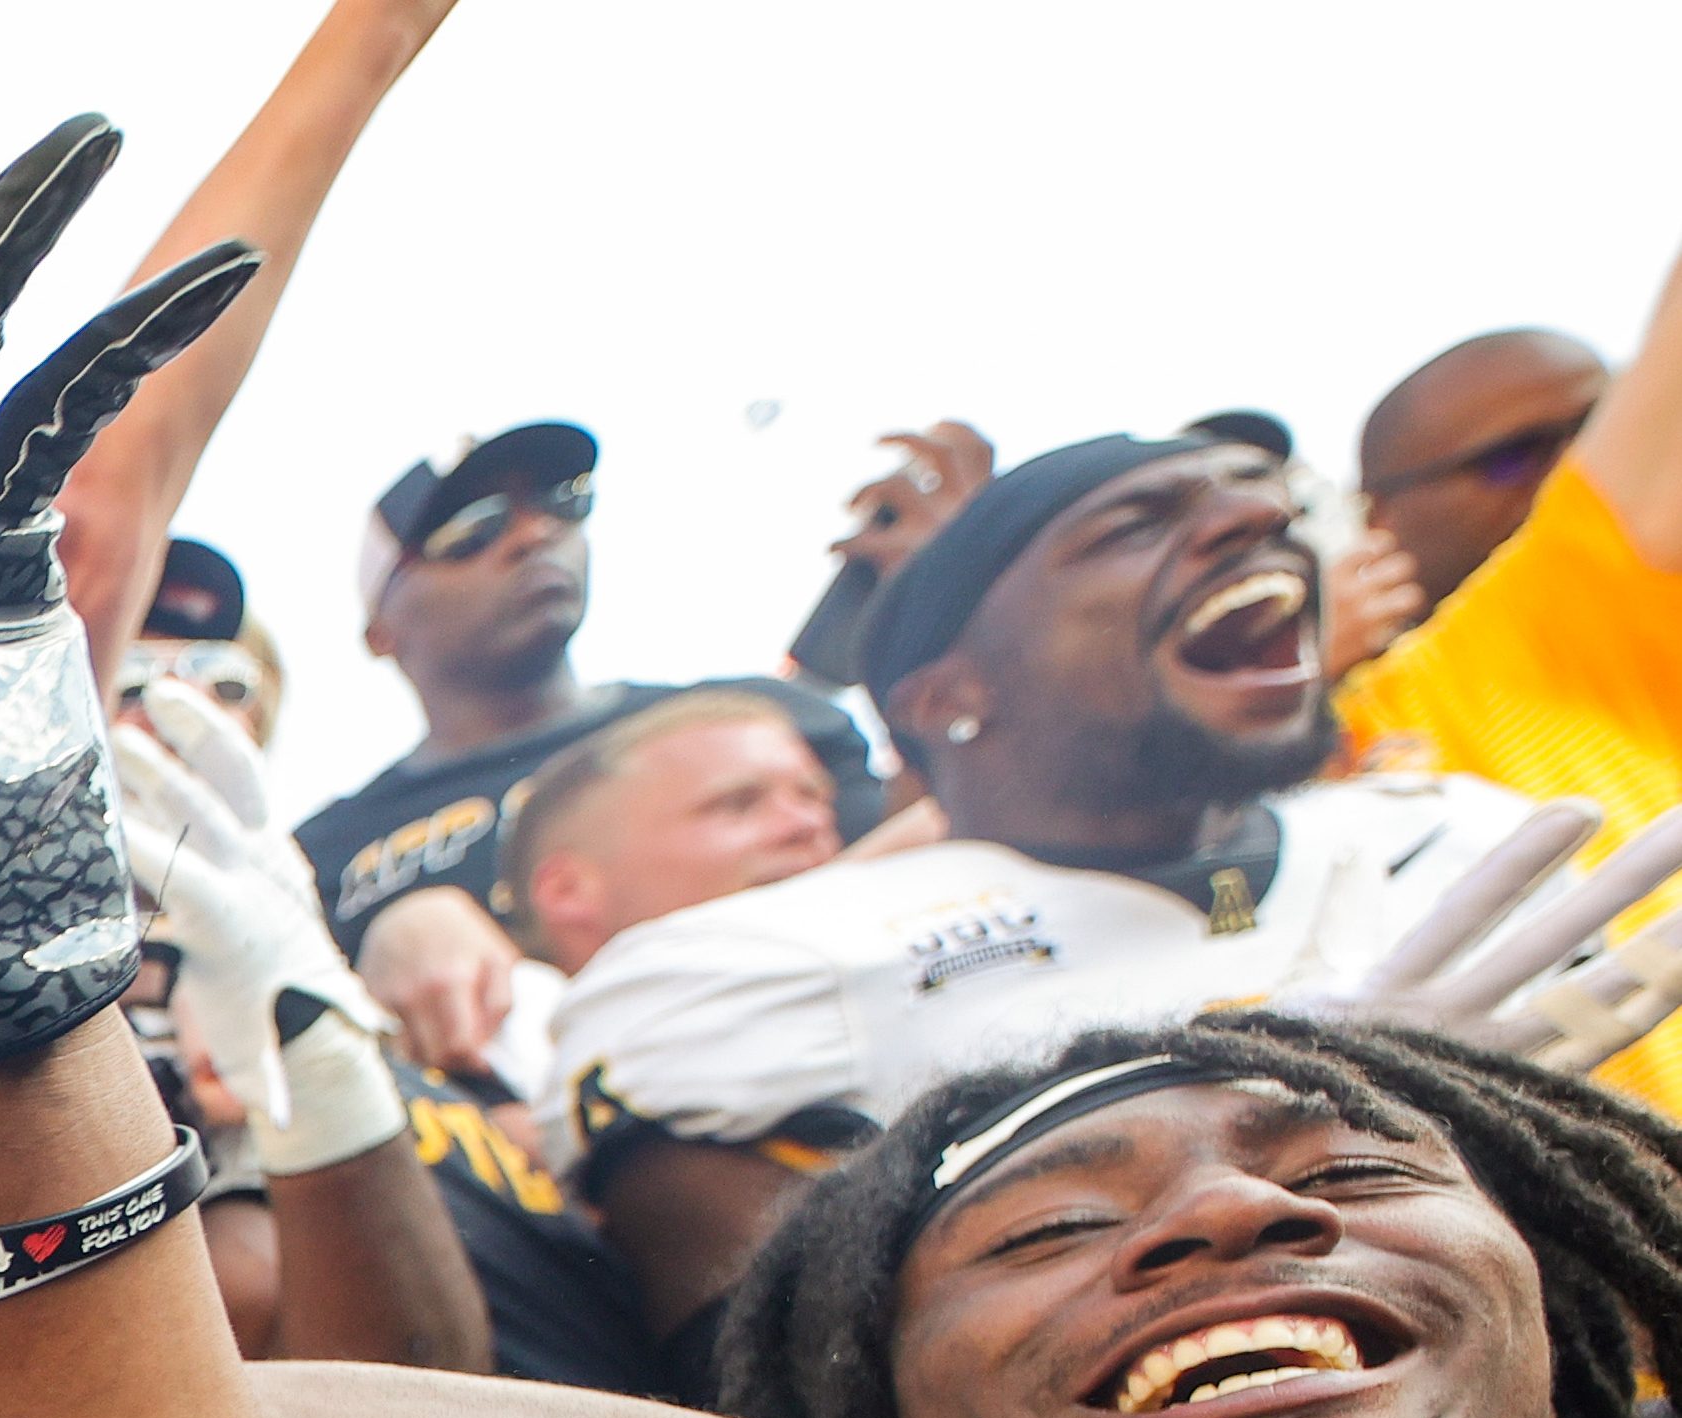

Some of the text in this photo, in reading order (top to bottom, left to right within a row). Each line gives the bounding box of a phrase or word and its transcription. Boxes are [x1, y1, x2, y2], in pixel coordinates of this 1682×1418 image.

[77, 1182, 165, 1233] THIS ONE
[81, 1201, 167, 1253] FOR YOU
